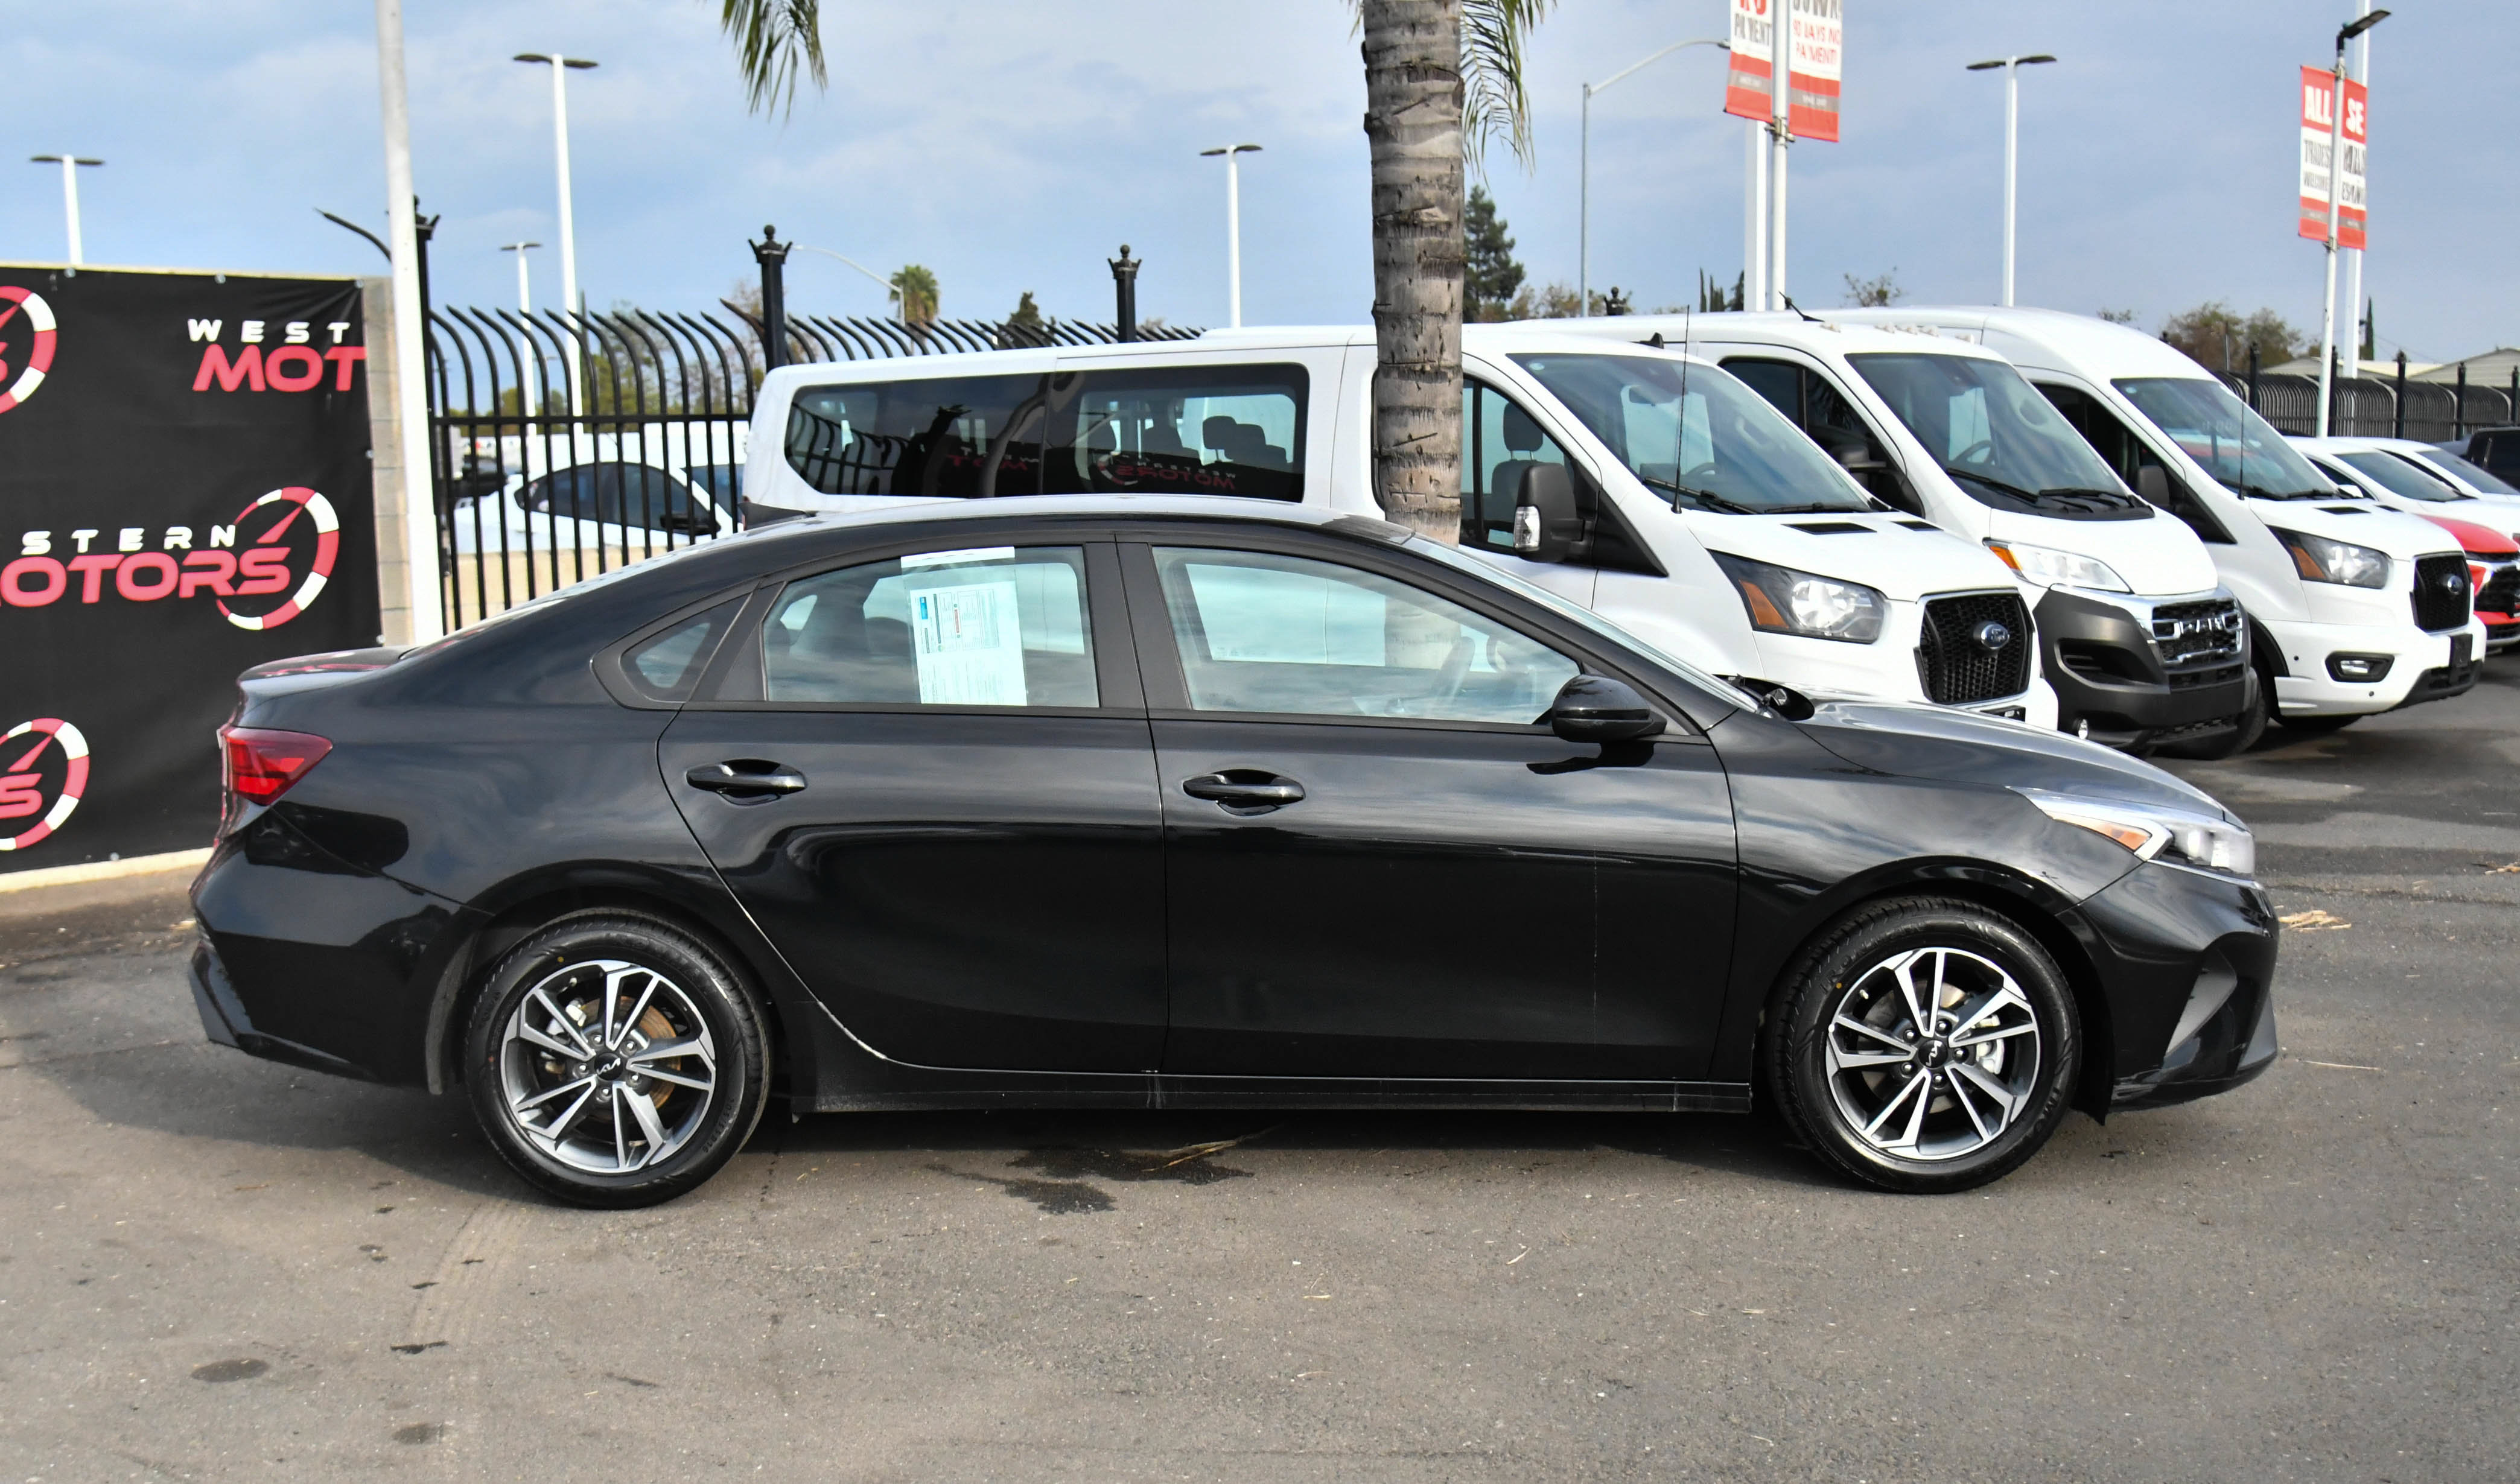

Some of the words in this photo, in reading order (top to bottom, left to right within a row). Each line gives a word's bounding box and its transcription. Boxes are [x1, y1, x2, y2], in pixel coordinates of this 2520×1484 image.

[2304, 84, 2332, 126] ALL
[2346, 97, 2364, 136] SE
[187, 318, 351, 344] WEST
[192, 343, 368, 392] MOT
[21, 524, 237, 556] STERN
[0, 547, 291, 608] OTORS
